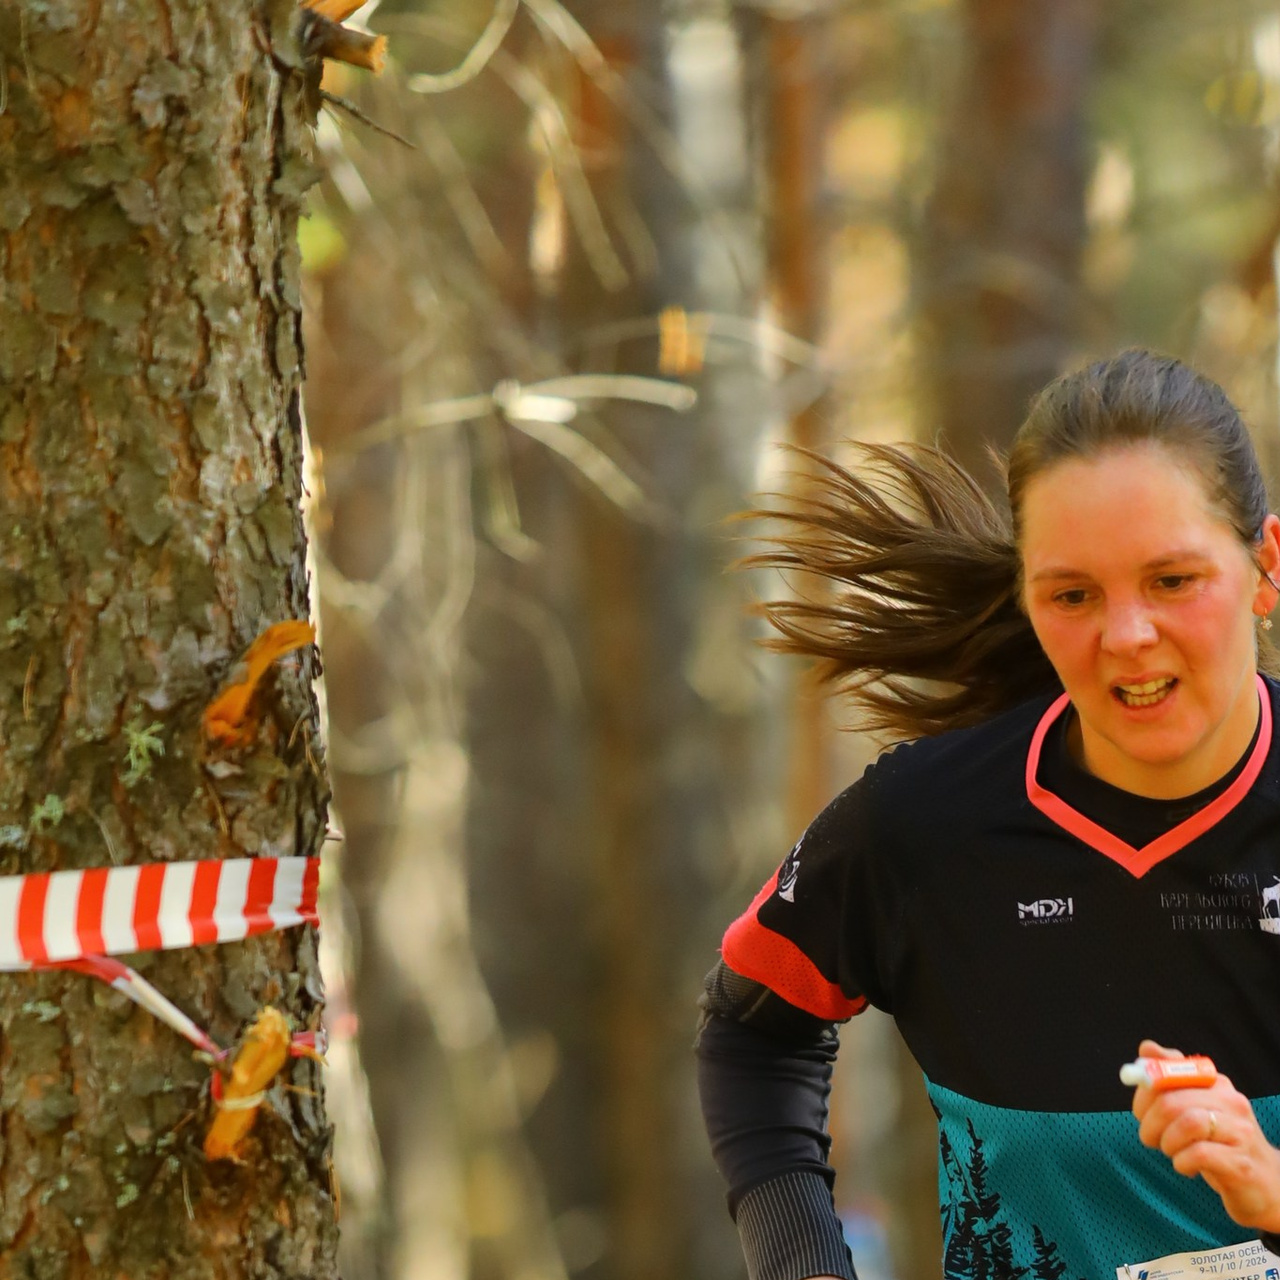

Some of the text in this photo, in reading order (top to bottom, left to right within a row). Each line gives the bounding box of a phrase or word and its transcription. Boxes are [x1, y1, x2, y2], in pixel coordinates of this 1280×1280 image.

[1190, 1251, 1235, 1265] ЗОЛОТАЯ
[1227, 1262, 1236, 1270] 10
[1246, 1255, 1267, 1267] 2026
